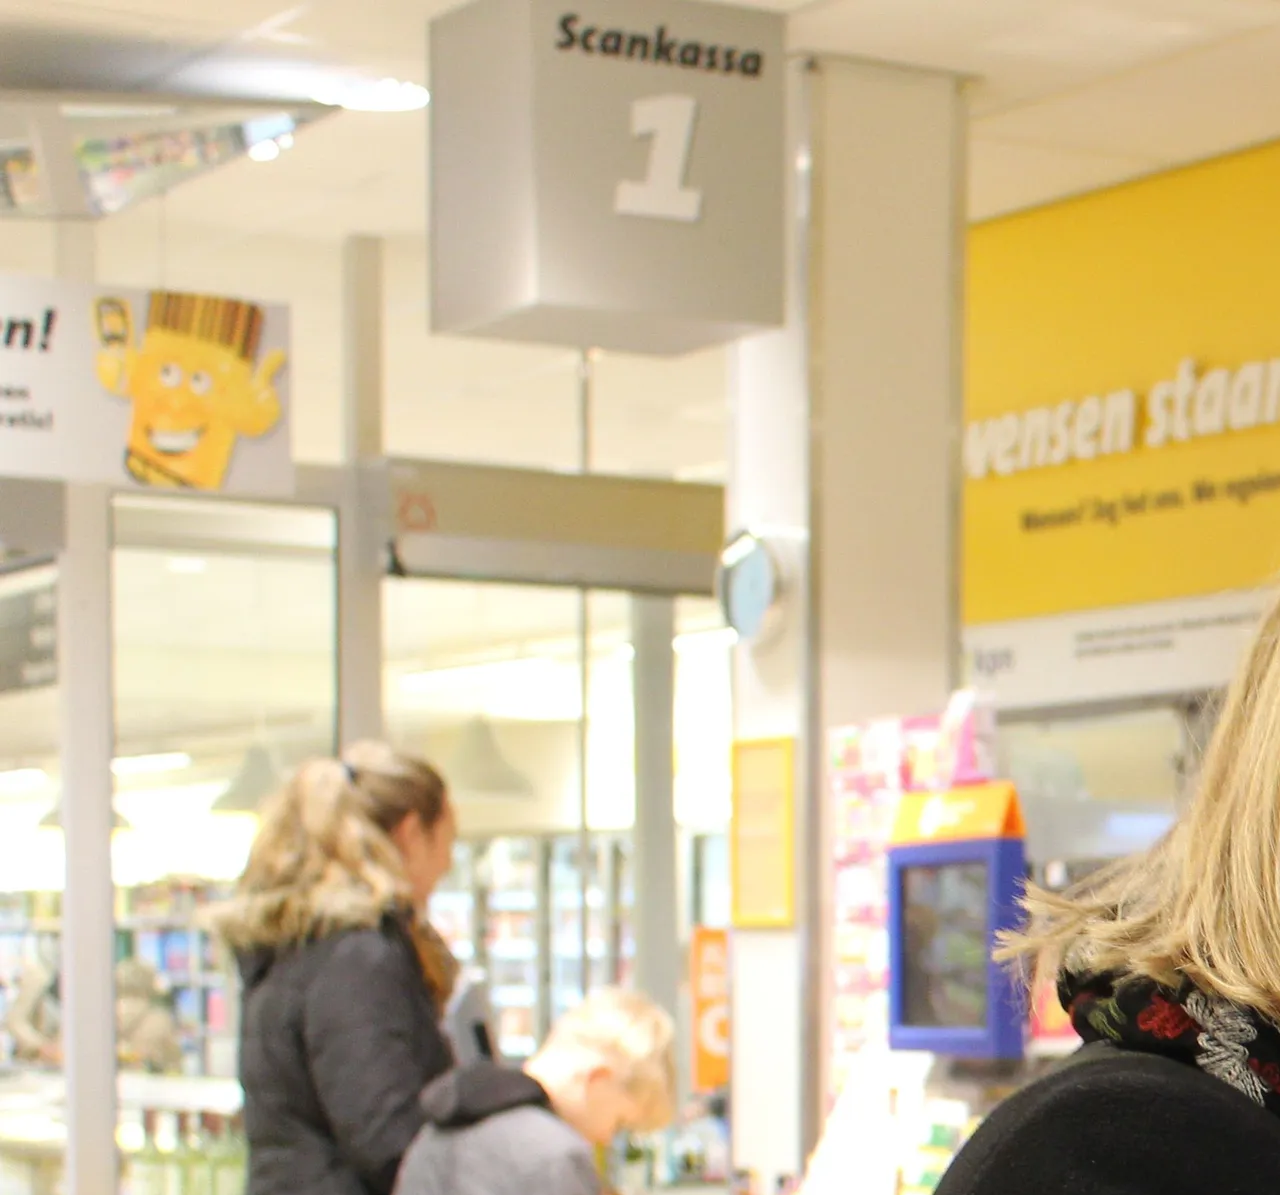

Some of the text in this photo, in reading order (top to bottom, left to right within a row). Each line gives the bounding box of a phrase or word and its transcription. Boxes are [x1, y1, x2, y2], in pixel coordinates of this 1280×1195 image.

[555, 12, 764, 79] Scankassa
[613, 92, 702, 222] 1
[0, 306, 57, 354] n!
